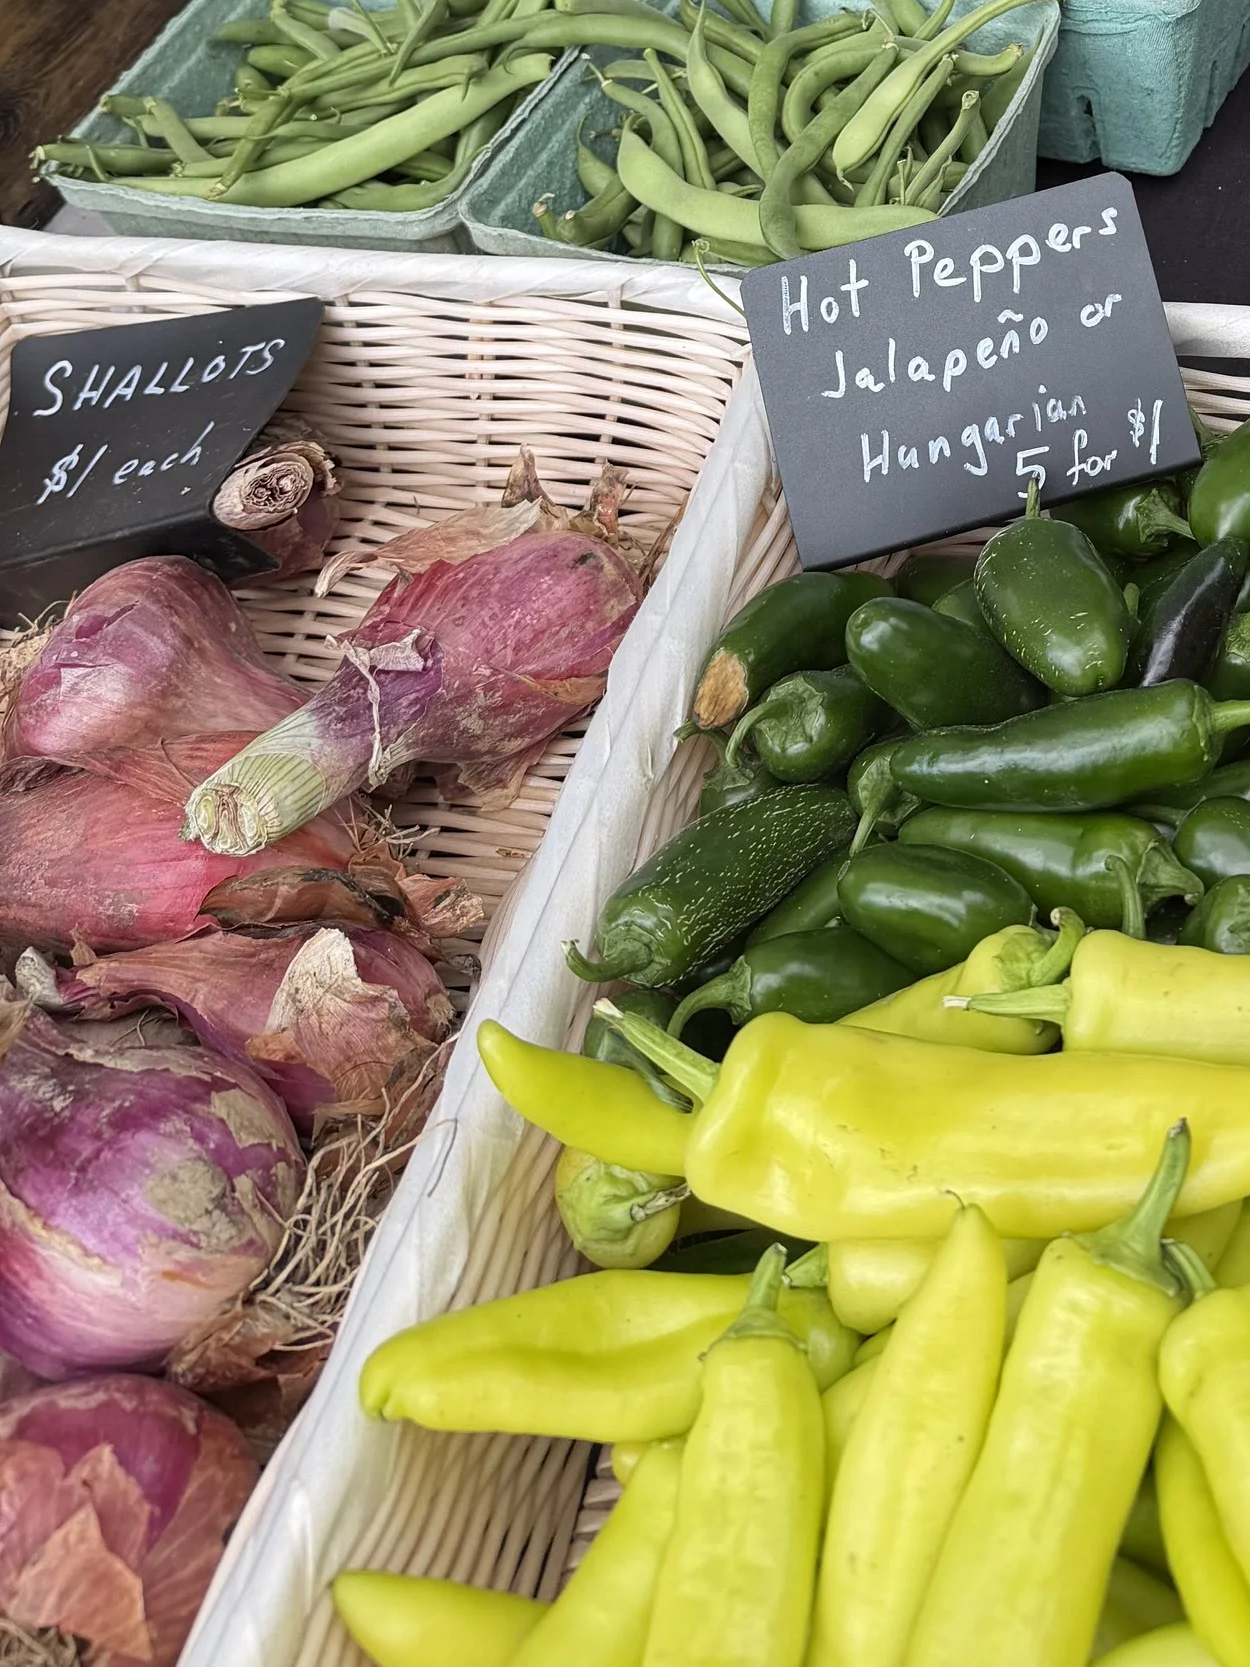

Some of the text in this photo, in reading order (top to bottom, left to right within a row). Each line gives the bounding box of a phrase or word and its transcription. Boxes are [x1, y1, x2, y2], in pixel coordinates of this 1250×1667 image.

[781, 207, 1118, 335] Hot Peppers
[32, 338, 286, 416] SHALLOTS
[821, 293, 1122, 399] Jalapeño or
[36, 421, 215, 506] $1 each
[861, 384, 1087, 483] Hungarian
[1015, 398, 1164, 499] 5 for $1
